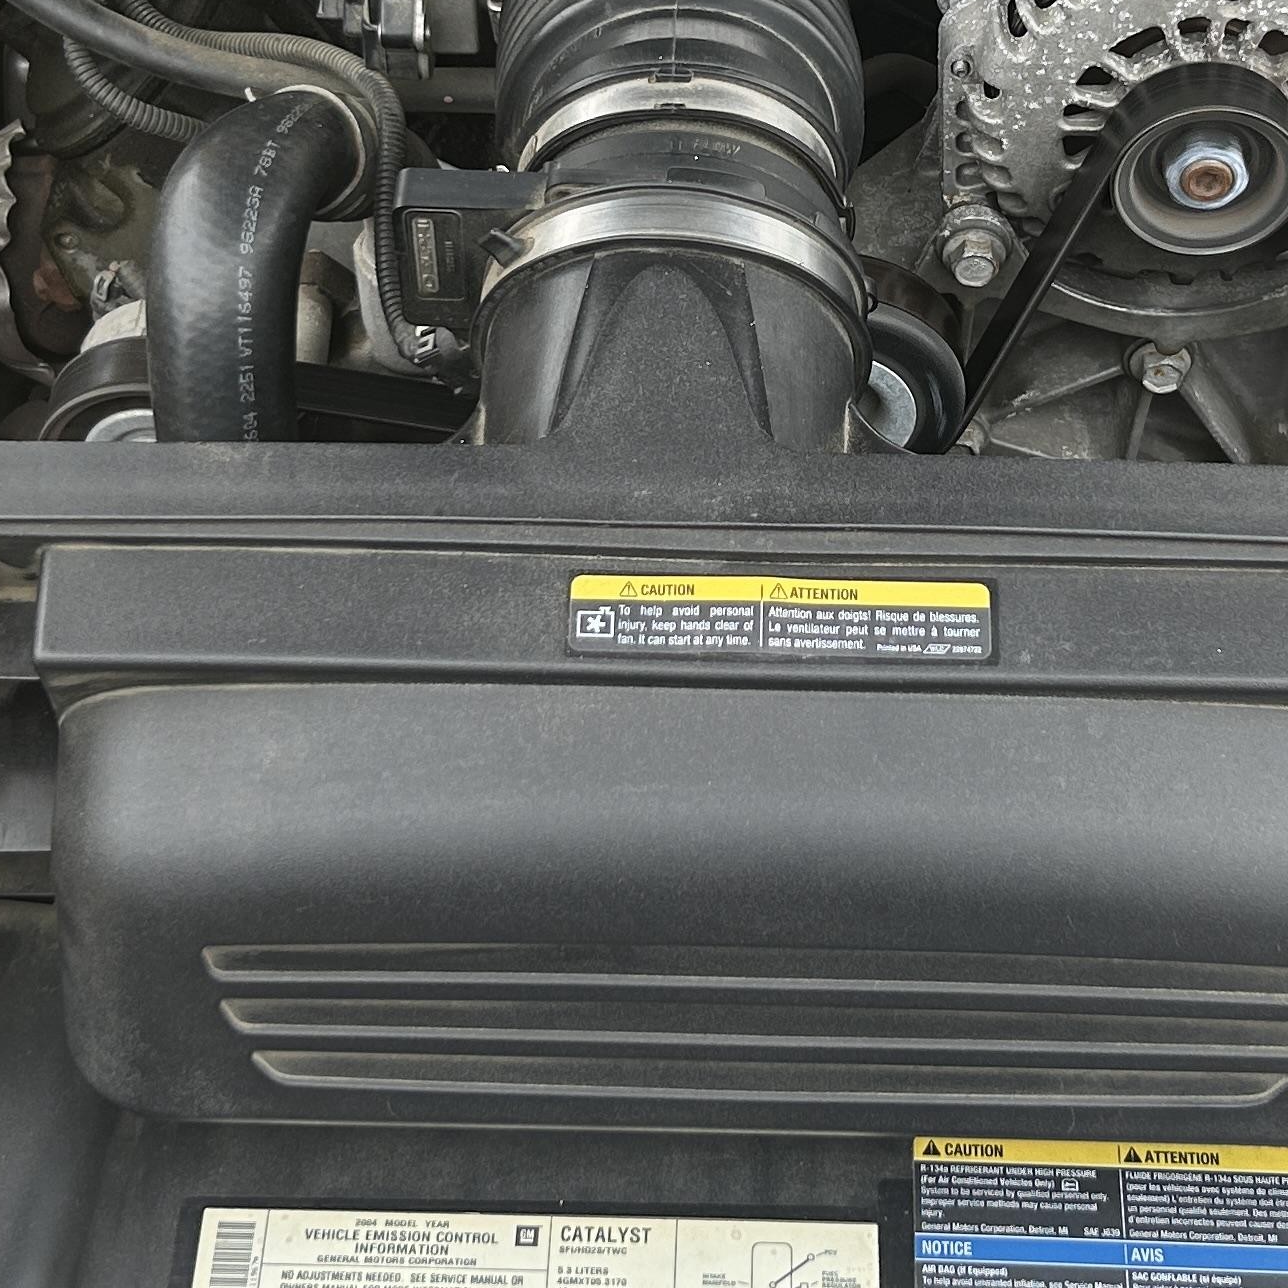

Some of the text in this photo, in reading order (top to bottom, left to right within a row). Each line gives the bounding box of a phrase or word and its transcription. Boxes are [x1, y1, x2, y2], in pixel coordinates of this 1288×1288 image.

[239, 364, 256, 403] 2251
[641, 583, 695, 596] CAUTION
[790, 586, 858, 601] ATTENTION
[619, 604, 754, 618] To help avoid personal
[768, 605, 979, 623] Attention aux doigts! Risque de blessures.
[618, 618, 754, 633] injury, keep hands clear of
[768, 620, 981, 638] Le ventilateur peut se mettre à tourner
[617, 633, 752, 648] fan. It can start at any time.
[768, 636, 792, 648] sans
[793, 636, 866, 650] avertissement.
[944, 1143, 1004, 1157] CAUTION
[1144, 1150, 1220, 1166] ATTENTION
[920, 1163, 949, 1173] R-134a
[950, 1164, 1004, 1175] REFRIGERANT
[1055, 1168, 1097, 1178] PRESSURE
[384, 1219, 418, 1228] MODEL
[425, 1220, 451, 1228] YEAR
[921, 1221, 952, 1232] General
[951, 1222, 980, 1232] Motors
[305, 1228, 499, 1244] VEHICLE EMISSION CONTROL
[519, 1228, 536, 1243] GM
[560, 1224, 653, 1244] CATALYST
[354, 1242, 450, 1256] INFORMATION
[921, 1239, 973, 1256] NOTICE
[1131, 1246, 1165, 1263] AVIS
[316, 1254, 478, 1266] GENERAL MOTORS CORPORATION
[575, 1266, 609, 1276] LITERS
[921, 1263, 937, 1273] AIR
[281, 1269, 295, 1280] NO
[296, 1270, 363, 1282] ADJUSTMENTS
[410, 1272, 427, 1283] SEE
[430, 1273, 468, 1284] SERVICE
[470, 1274, 509, 1285] MANUAL
[511, 1274, 524, 1286] OR
[922, 1275, 933, 1285] To
[933, 1276, 951, 1287] help
[952, 1277, 973, 1287] avoid
[1131, 1271, 1150, 1281] SAC
